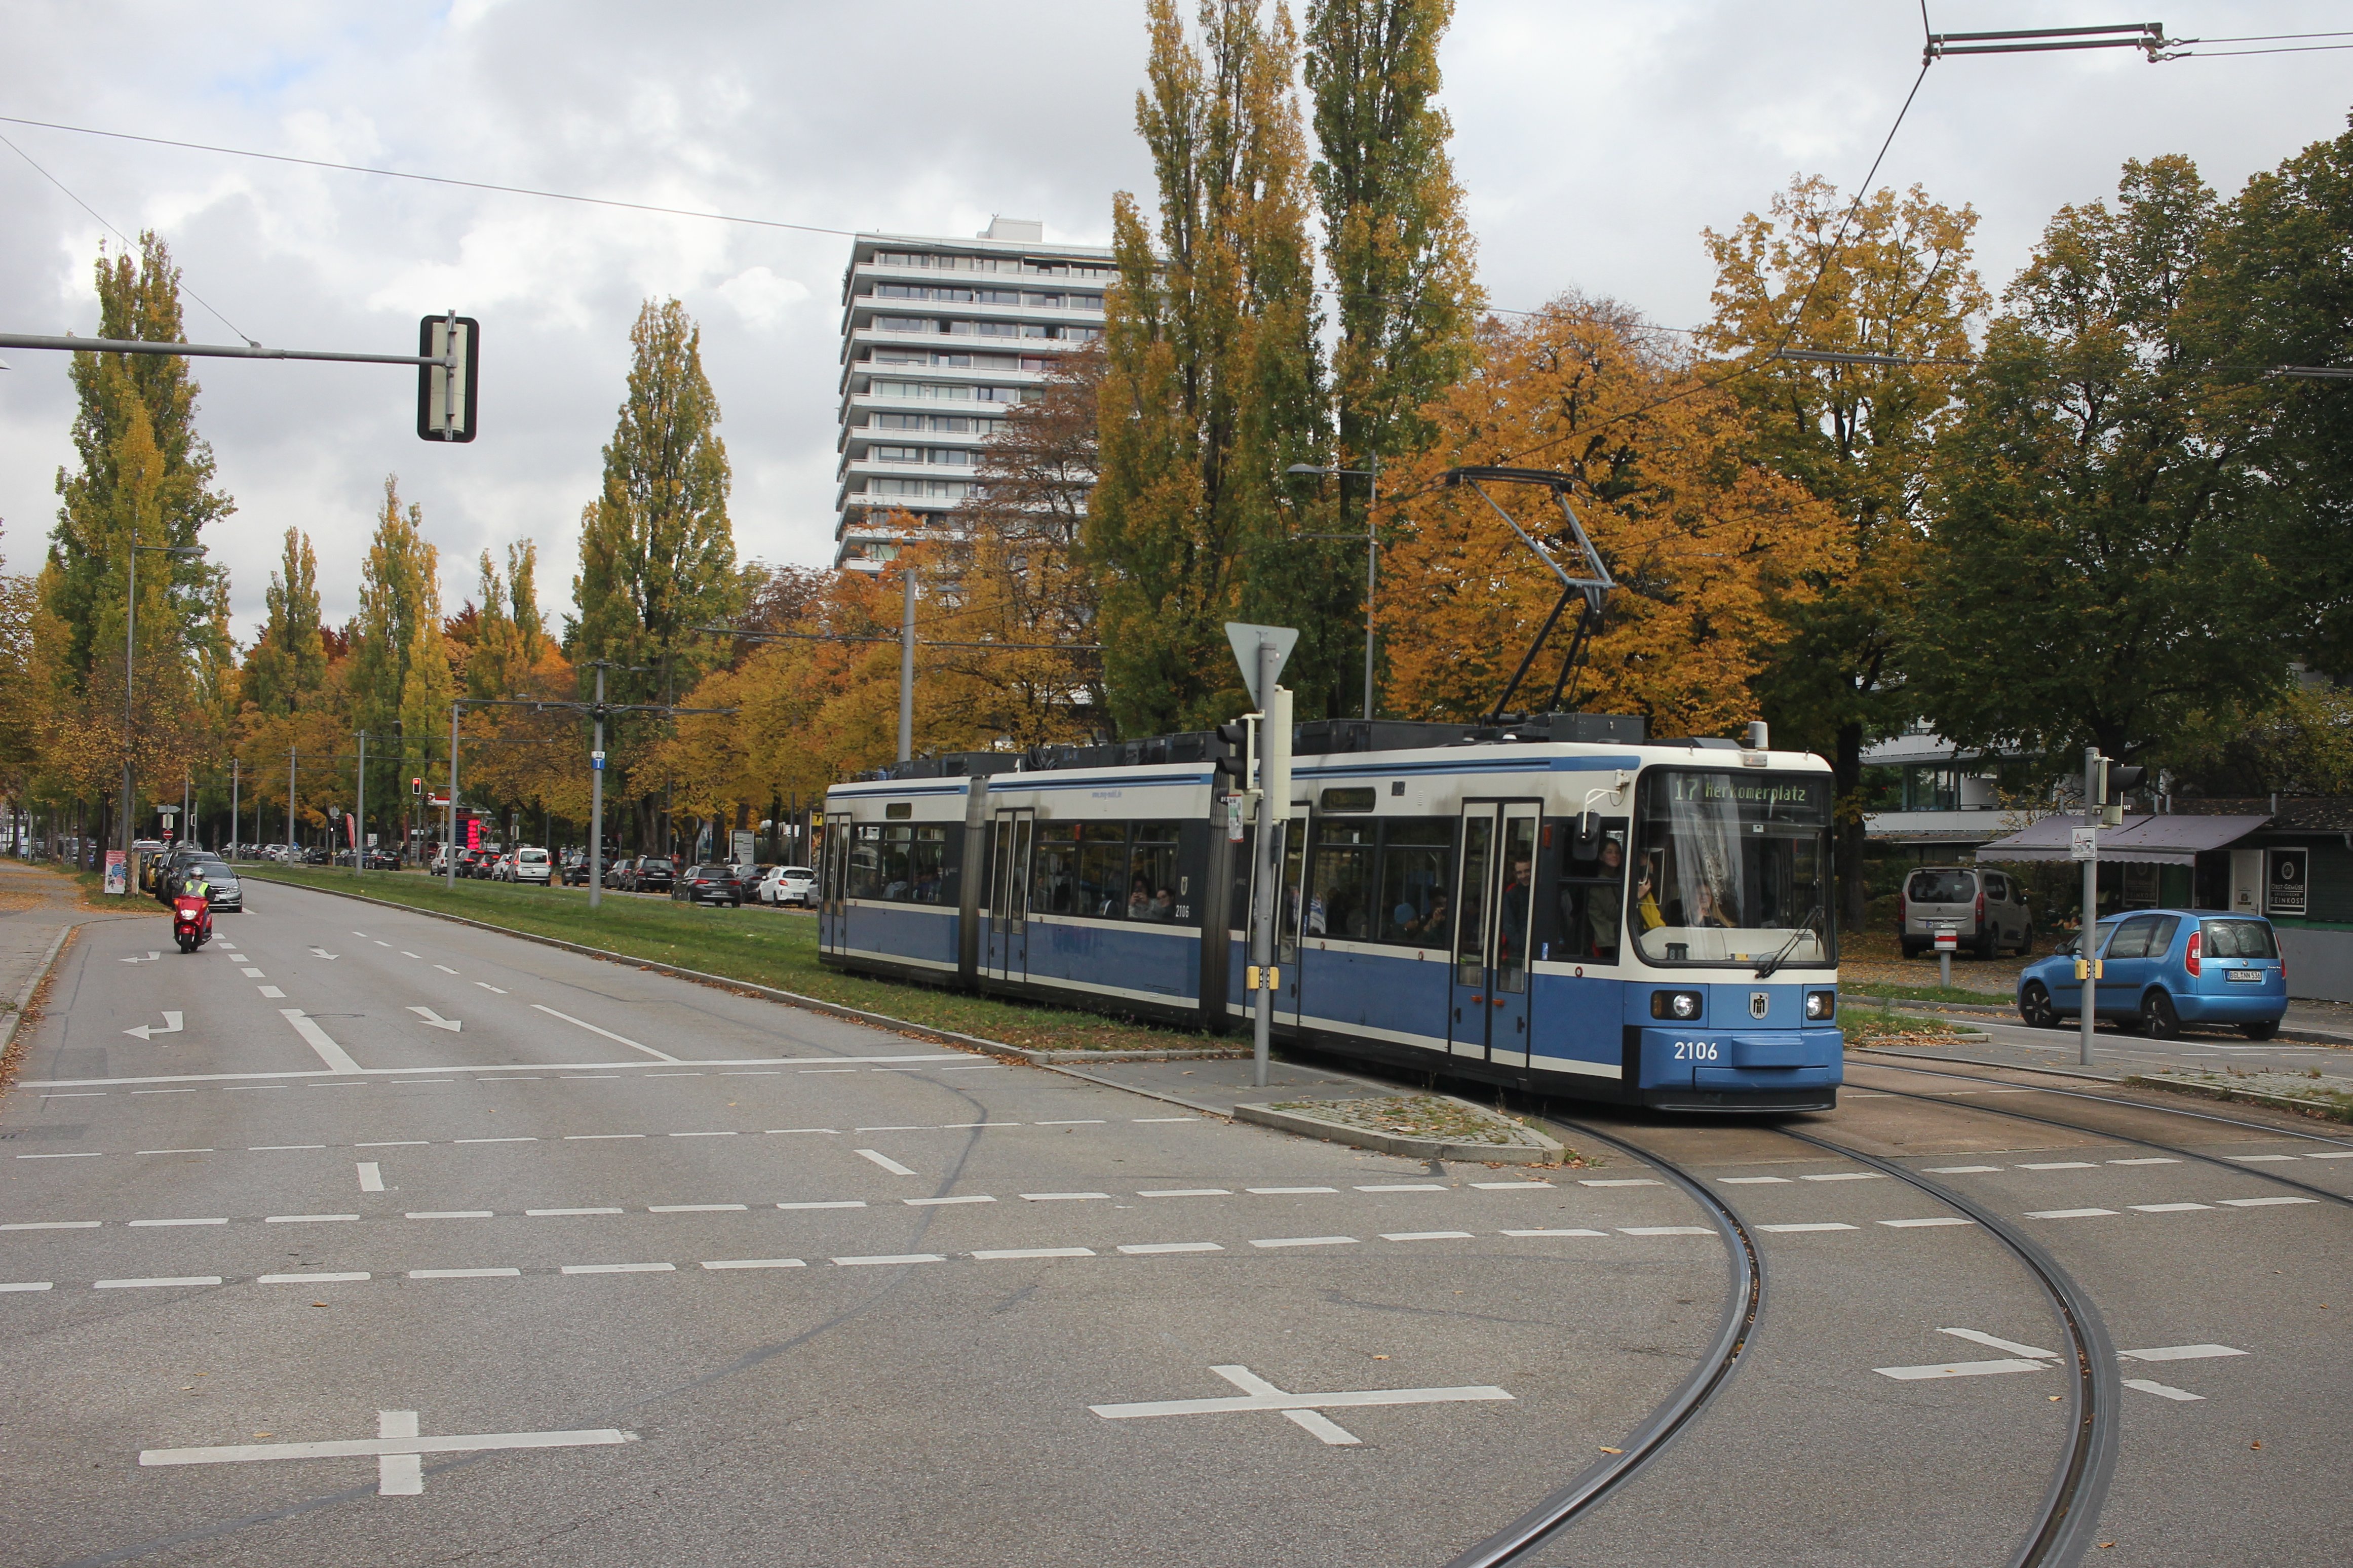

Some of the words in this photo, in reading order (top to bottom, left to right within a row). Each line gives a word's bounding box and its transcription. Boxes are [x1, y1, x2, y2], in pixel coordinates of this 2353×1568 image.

[595, 759, 602, 768] T
[1675, 778, 1699, 801] 17
[1705, 781, 1806, 802] Herkomerplatz
[1175, 904, 1190, 918] 2106
[1674, 1041, 1718, 1061] 2106
